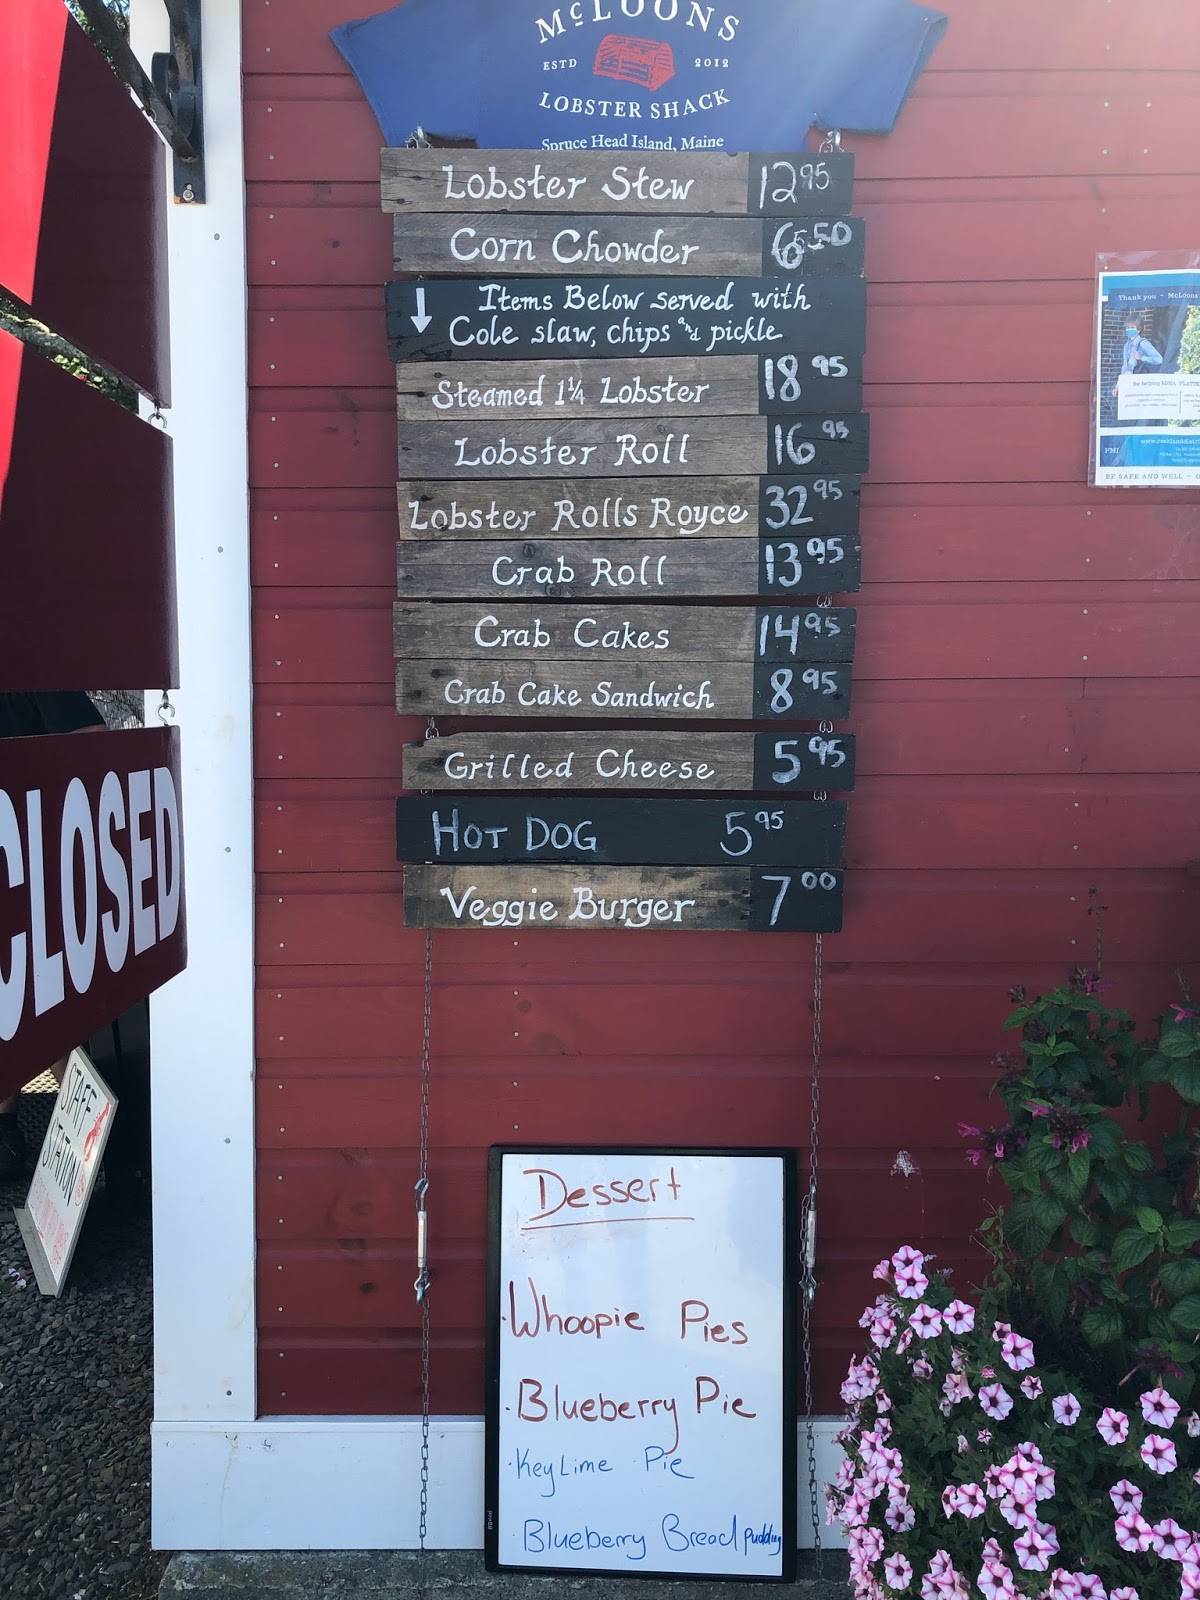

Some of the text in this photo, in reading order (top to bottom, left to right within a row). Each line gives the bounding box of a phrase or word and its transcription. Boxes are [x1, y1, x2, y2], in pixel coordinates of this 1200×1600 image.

[543, 58, 730, 71] ESTD 2012
[538, 88, 731, 120] LOBSTER SHACK
[541, 133, 725, 152] Spruce Head Island, Maine
[442, 163, 588, 200] Lobster
[601, 165, 695, 200] Stew
[450, 227, 536, 262] Corn
[552, 227, 700, 265] Chowder
[478, 281, 812, 311] Items Below served with
[1119, 293, 1141, 301] Thank
[448, 315, 783, 353] Cole slaw, chips and pickle
[431, 374, 545, 410] Steamed
[600, 375, 710, 405] Lobster
[454, 438, 598, 467] Lobster
[614, 433, 690, 467] Roll
[408, 501, 537, 532] Lobster
[551, 497, 638, 532] Rolls
[648, 497, 749, 535] Royce
[491, 555, 575, 586] Crab
[591, 555, 667, 587] Roll
[474, 615, 551, 649] Crab
[573, 617, 671, 650] Cakes
[444, 679, 506, 705] Crab
[517, 681, 582, 706] Cake
[591, 680, 715, 710] Sandwich
[444, 750, 573, 780] Grilled
[595, 748, 716, 780] Cheese
[431, 808, 508, 855] HOT
[526, 814, 598, 853] DOG
[440, 885, 559, 928] Veggie
[568, 884, 696, 928] Burger
[61, 1062, 97, 1137] STAFF
[522, 1167, 681, 1221] Dessert
[508, 1277, 749, 1344] Whoopie Pies
[518, 1376, 757, 1455] Blueberry Pie
[644, 1446, 694, 1480] Pie
[523, 1518, 647, 1560] Blueberry
[661, 1512, 738, 1552] Bread
